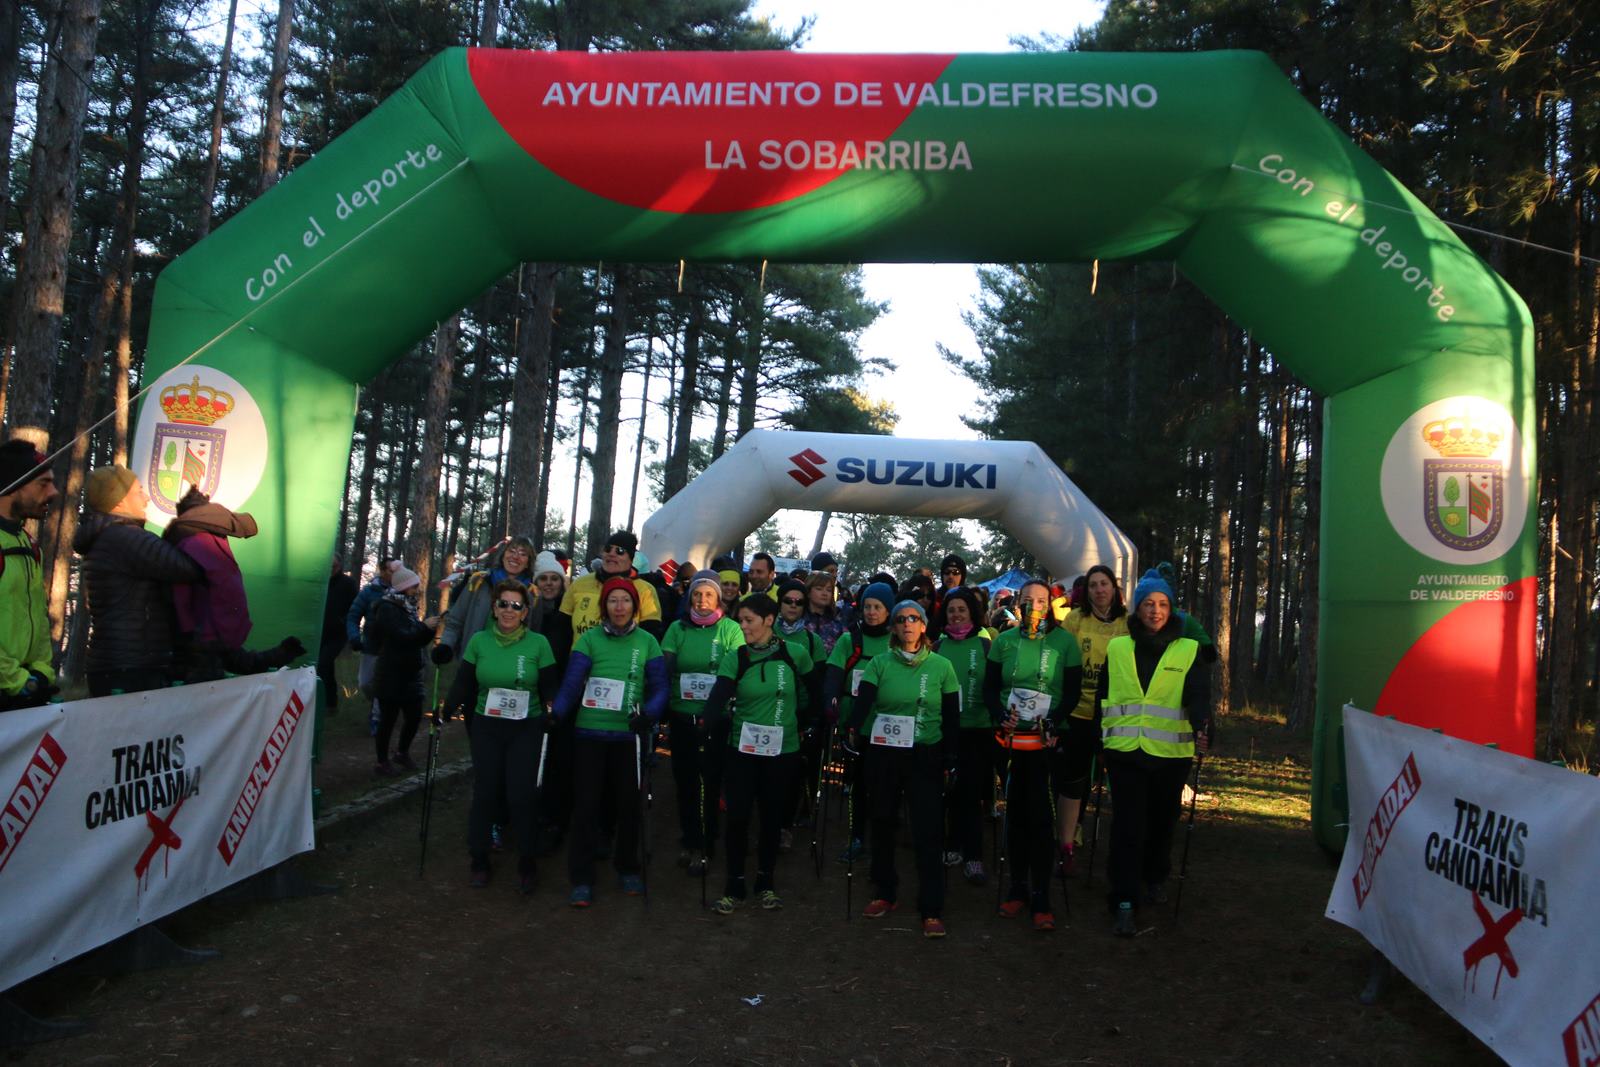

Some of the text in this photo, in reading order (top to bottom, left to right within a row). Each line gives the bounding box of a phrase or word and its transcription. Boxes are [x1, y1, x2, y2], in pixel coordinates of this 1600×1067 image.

[541, 81, 1160, 109] AYUNTAMIENTO DE VALDEFRESNO
[704, 140, 974, 171] LA SOBARRIBA
[245, 144, 443, 301] Con el deporte
[1259, 154, 1456, 322] Con el deporte
[835, 456, 997, 490] SUZUKI
[1417, 574, 1509, 586] AYUNTAMIENTO
[1410, 589, 1514, 601] DE VALDEFRESNO
[593, 686, 611, 698] 67
[690, 680, 706, 690] 56
[499, 697, 517, 709] 58
[1018, 699, 1037, 711] 53
[753, 733, 771, 745] 13
[883, 723, 901, 736] 66
[111, 733, 186, 785] TRANS
[224, 697, 302, 855] ANIBALADA!
[84, 765, 201, 830] CANDAMIA
[1453, 797, 1529, 869] TRANS
[1424, 831, 1548, 928] CANDAMIA
